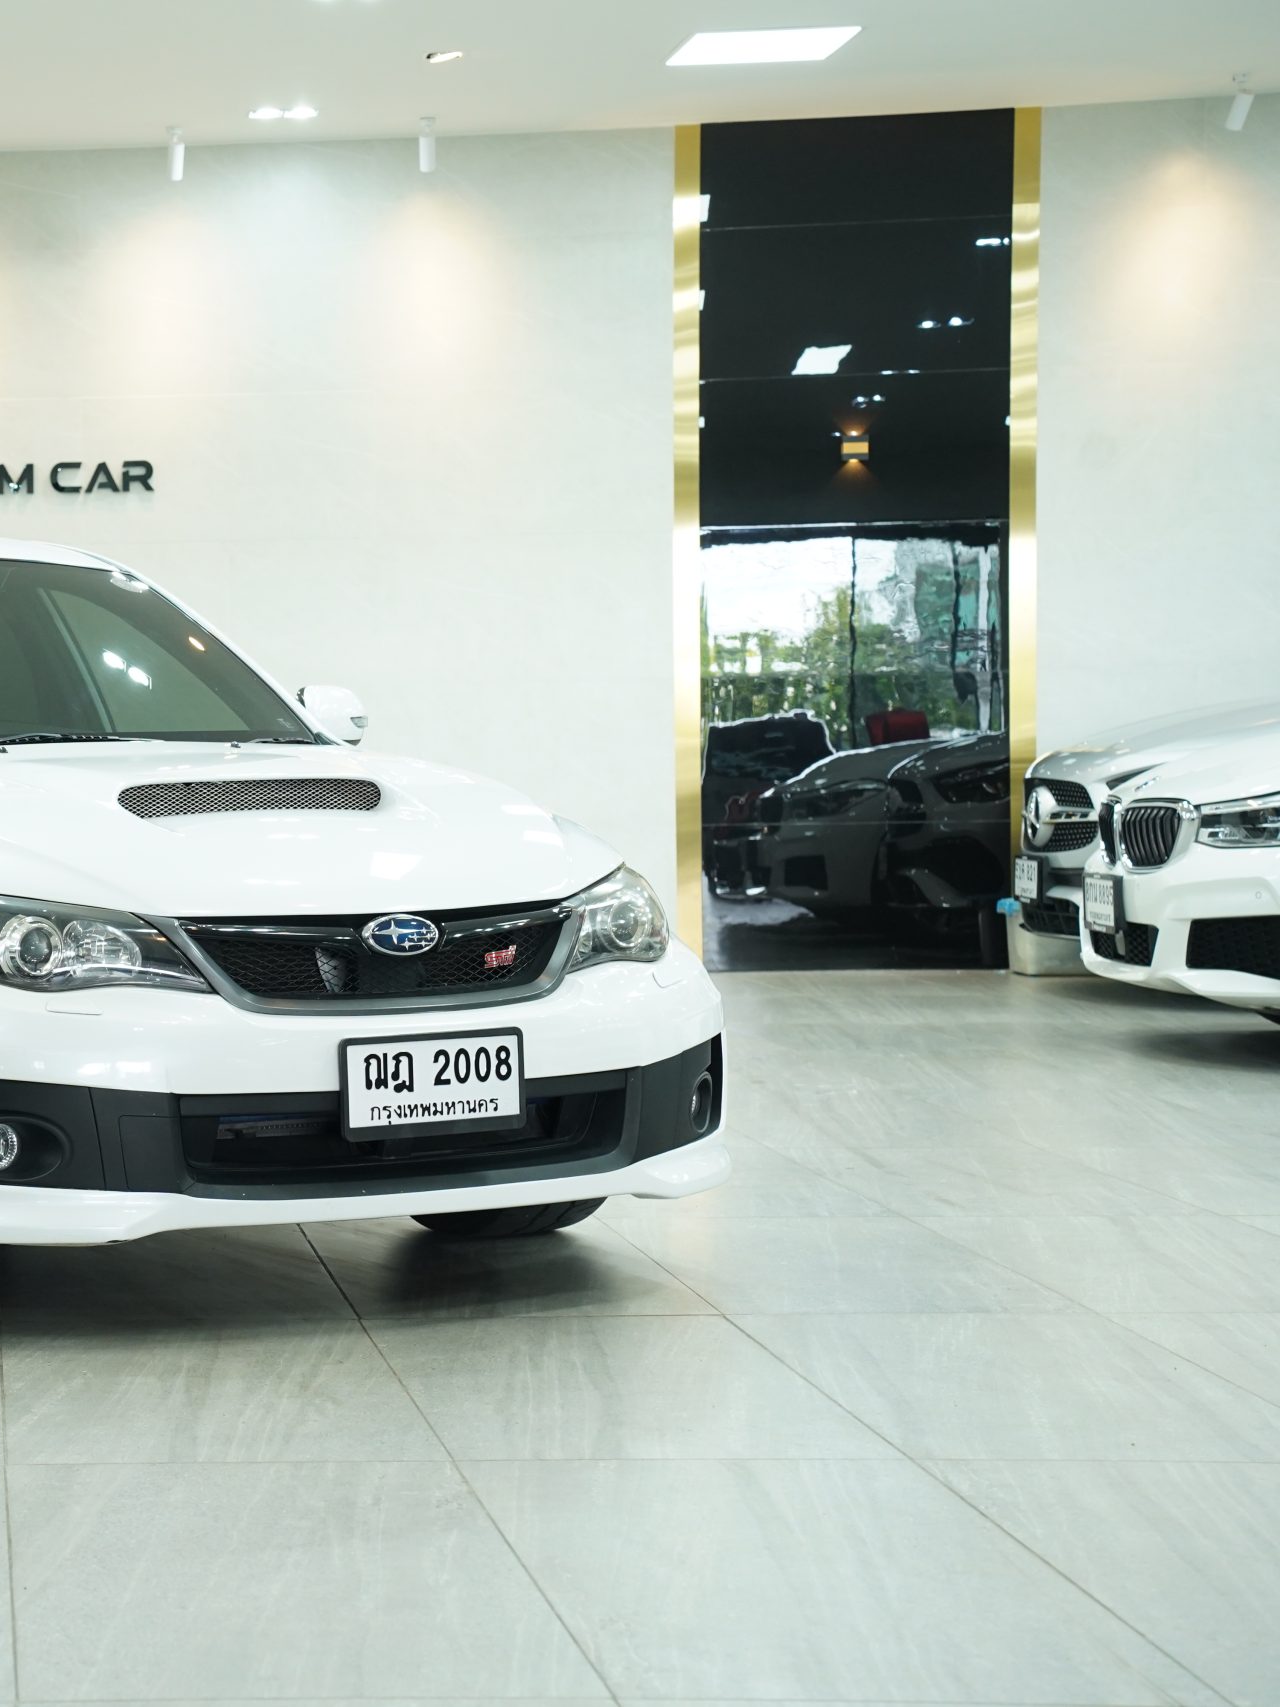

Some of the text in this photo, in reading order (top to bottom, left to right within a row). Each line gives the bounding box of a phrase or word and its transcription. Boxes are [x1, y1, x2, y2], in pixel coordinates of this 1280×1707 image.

[50, 460, 153, 493] CAR
[433, 1045, 512, 1086] 2008
[370, 1098, 499, 1125] กรุงเทพมหานคร
